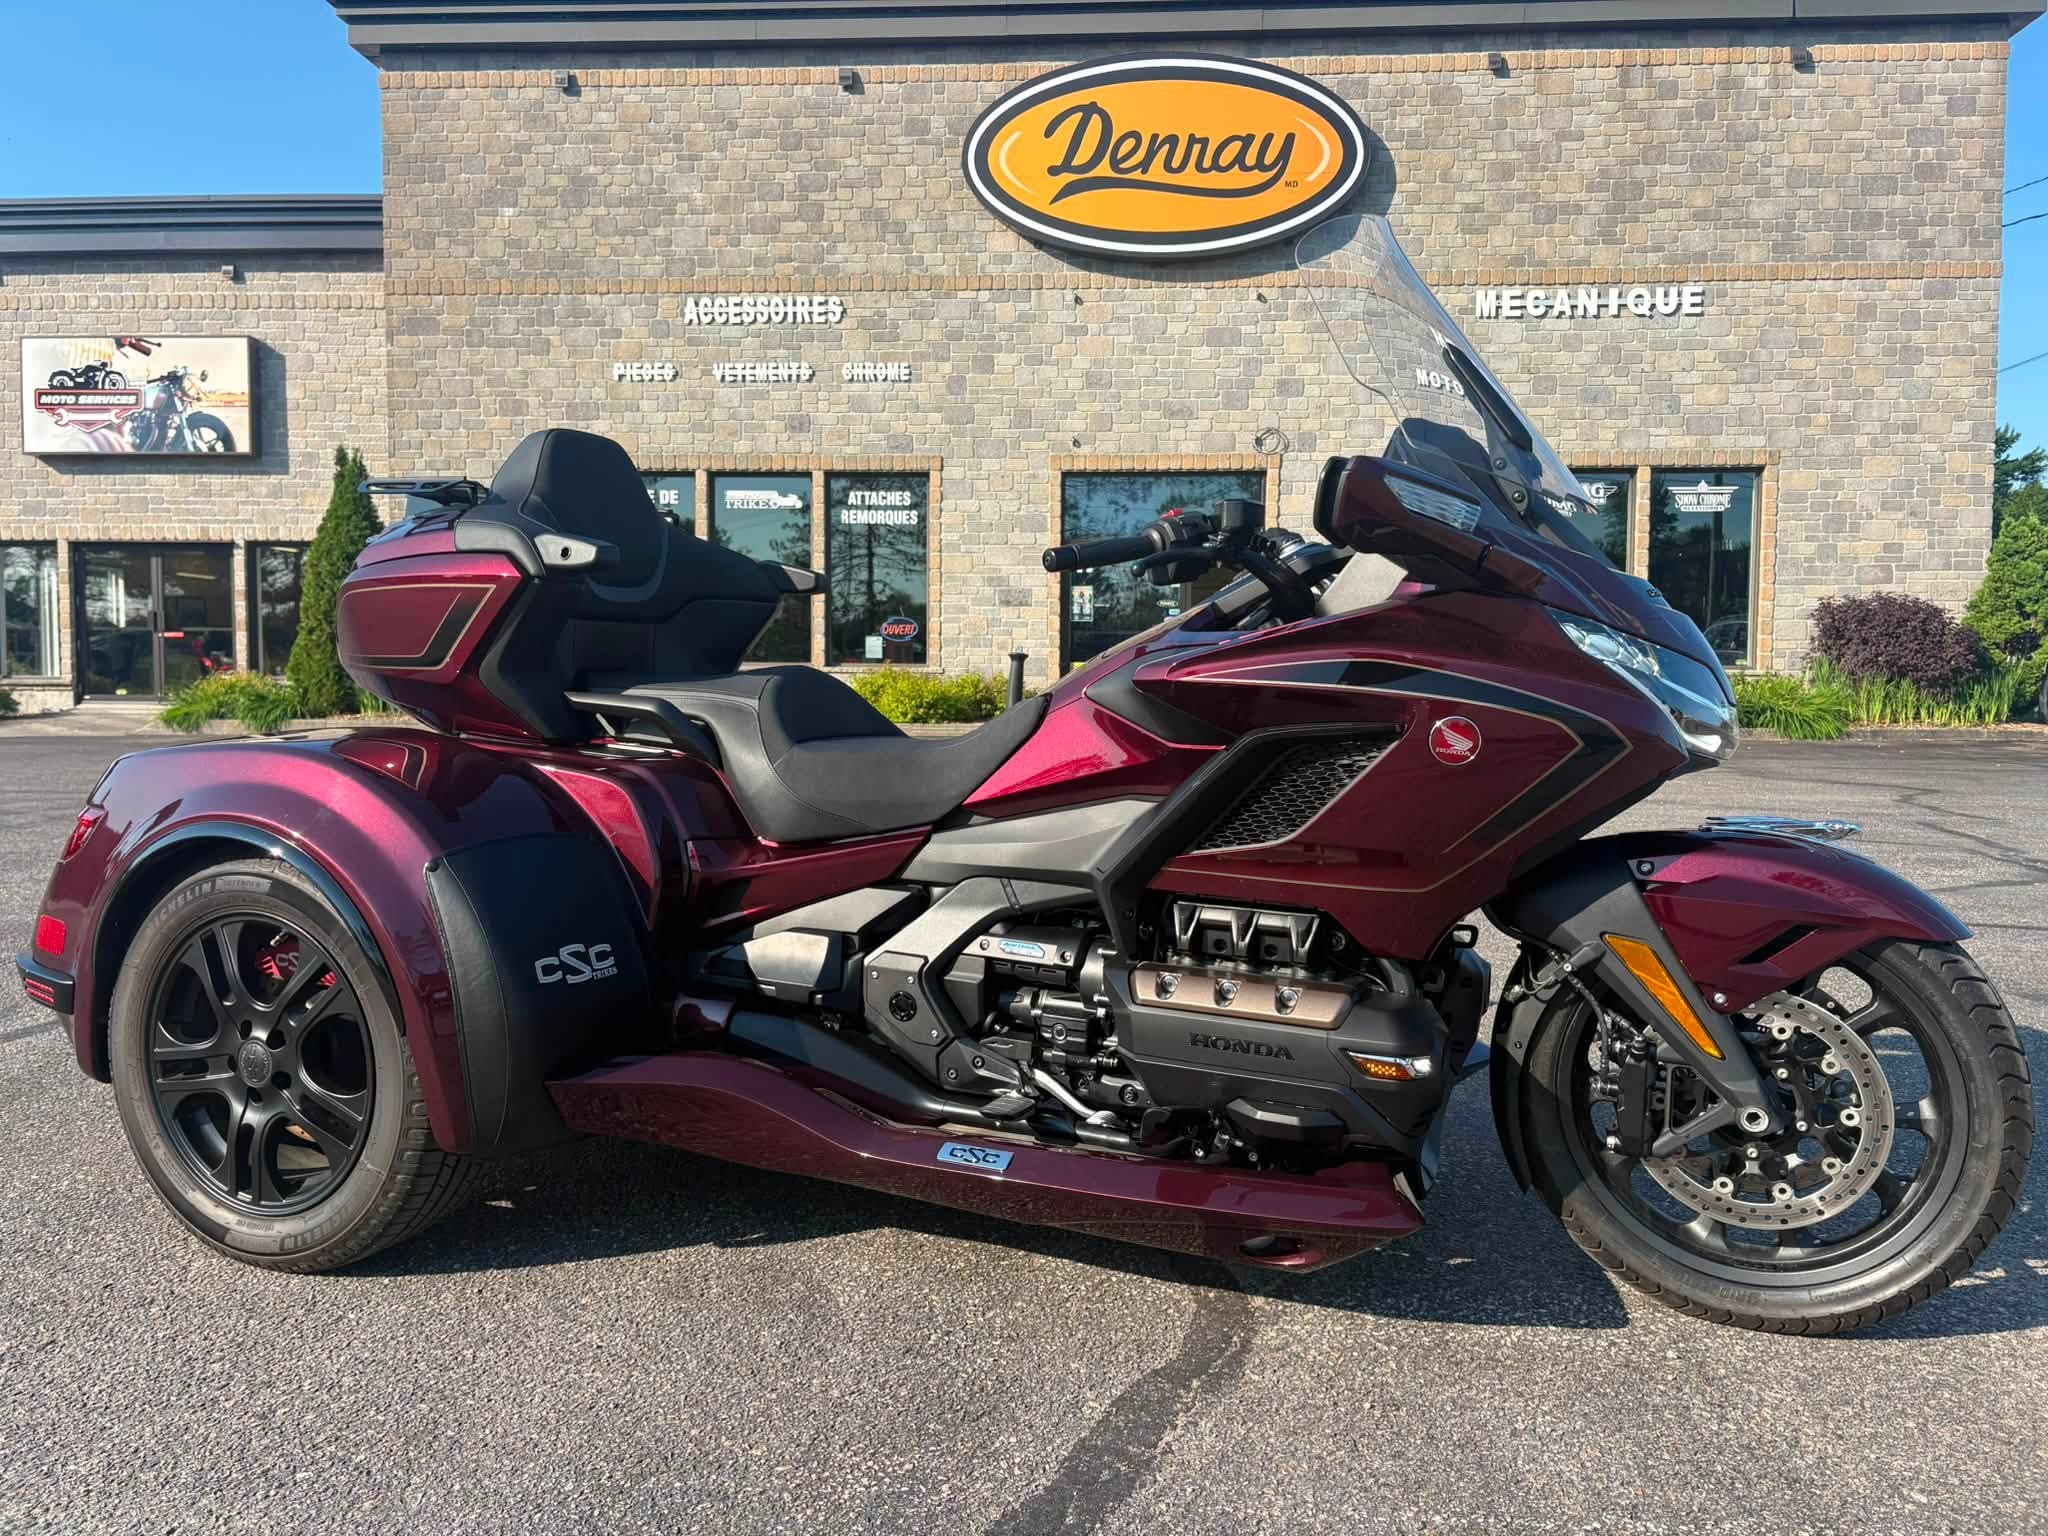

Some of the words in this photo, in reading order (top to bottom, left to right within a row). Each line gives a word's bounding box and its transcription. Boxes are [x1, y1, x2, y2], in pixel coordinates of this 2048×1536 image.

[1043, 101, 1297, 206] Denray
[1284, 180, 1299, 189] MD
[683, 295, 845, 325] ACCESSOIRES
[1475, 286, 1705, 319] MECANIQUE
[612, 362, 678, 382] PIECES
[712, 362, 815, 383] VETEMENTS
[842, 362, 911, 383] CHROME
[1416, 368, 1465, 397] MOTO
[39, 393, 76, 405] MOTO
[659, 489, 679, 504] DE
[848, 490, 911, 506] ATTACHES
[841, 510, 918, 525] REMORQUES
[882, 623, 915, 636] OUVERT
[1189, 1032, 1296, 1061] HONDA
